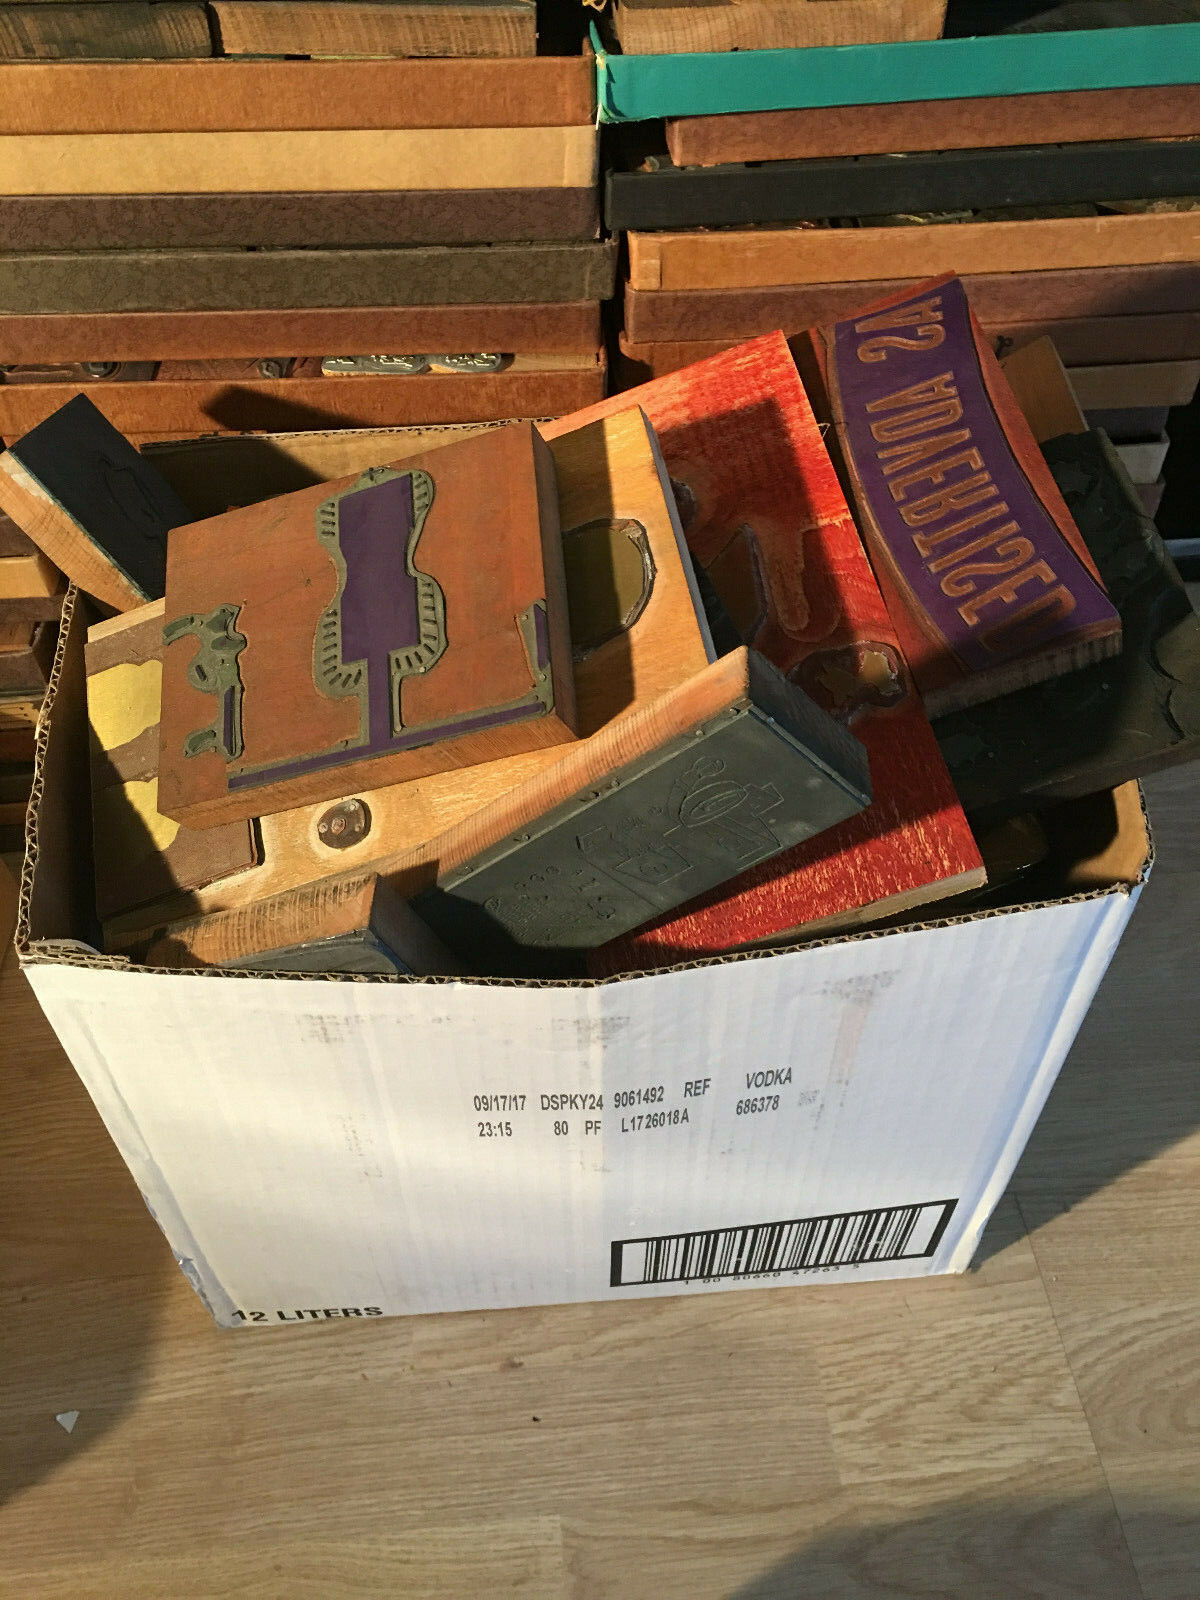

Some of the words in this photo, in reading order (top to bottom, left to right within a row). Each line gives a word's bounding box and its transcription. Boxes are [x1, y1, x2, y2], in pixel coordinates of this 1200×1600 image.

[473, 1094, 527, 1112] 09/17/17
[540, 1093, 604, 1111] DSPKY24
[613, 1085, 665, 1109] 9061492
[683, 1078, 711, 1099] REF
[745, 1067, 793, 1090] VODKA
[477, 1121, 513, 1137] 23:15
[553, 1120, 569, 1136] 80
[584, 1120, 602, 1136] PF
[621, 1108, 690, 1133] L1726018A
[735, 1094, 780, 1116] 686378
[231, 1309, 269, 1322] 12
[276, 1306, 384, 1321] LITERS
